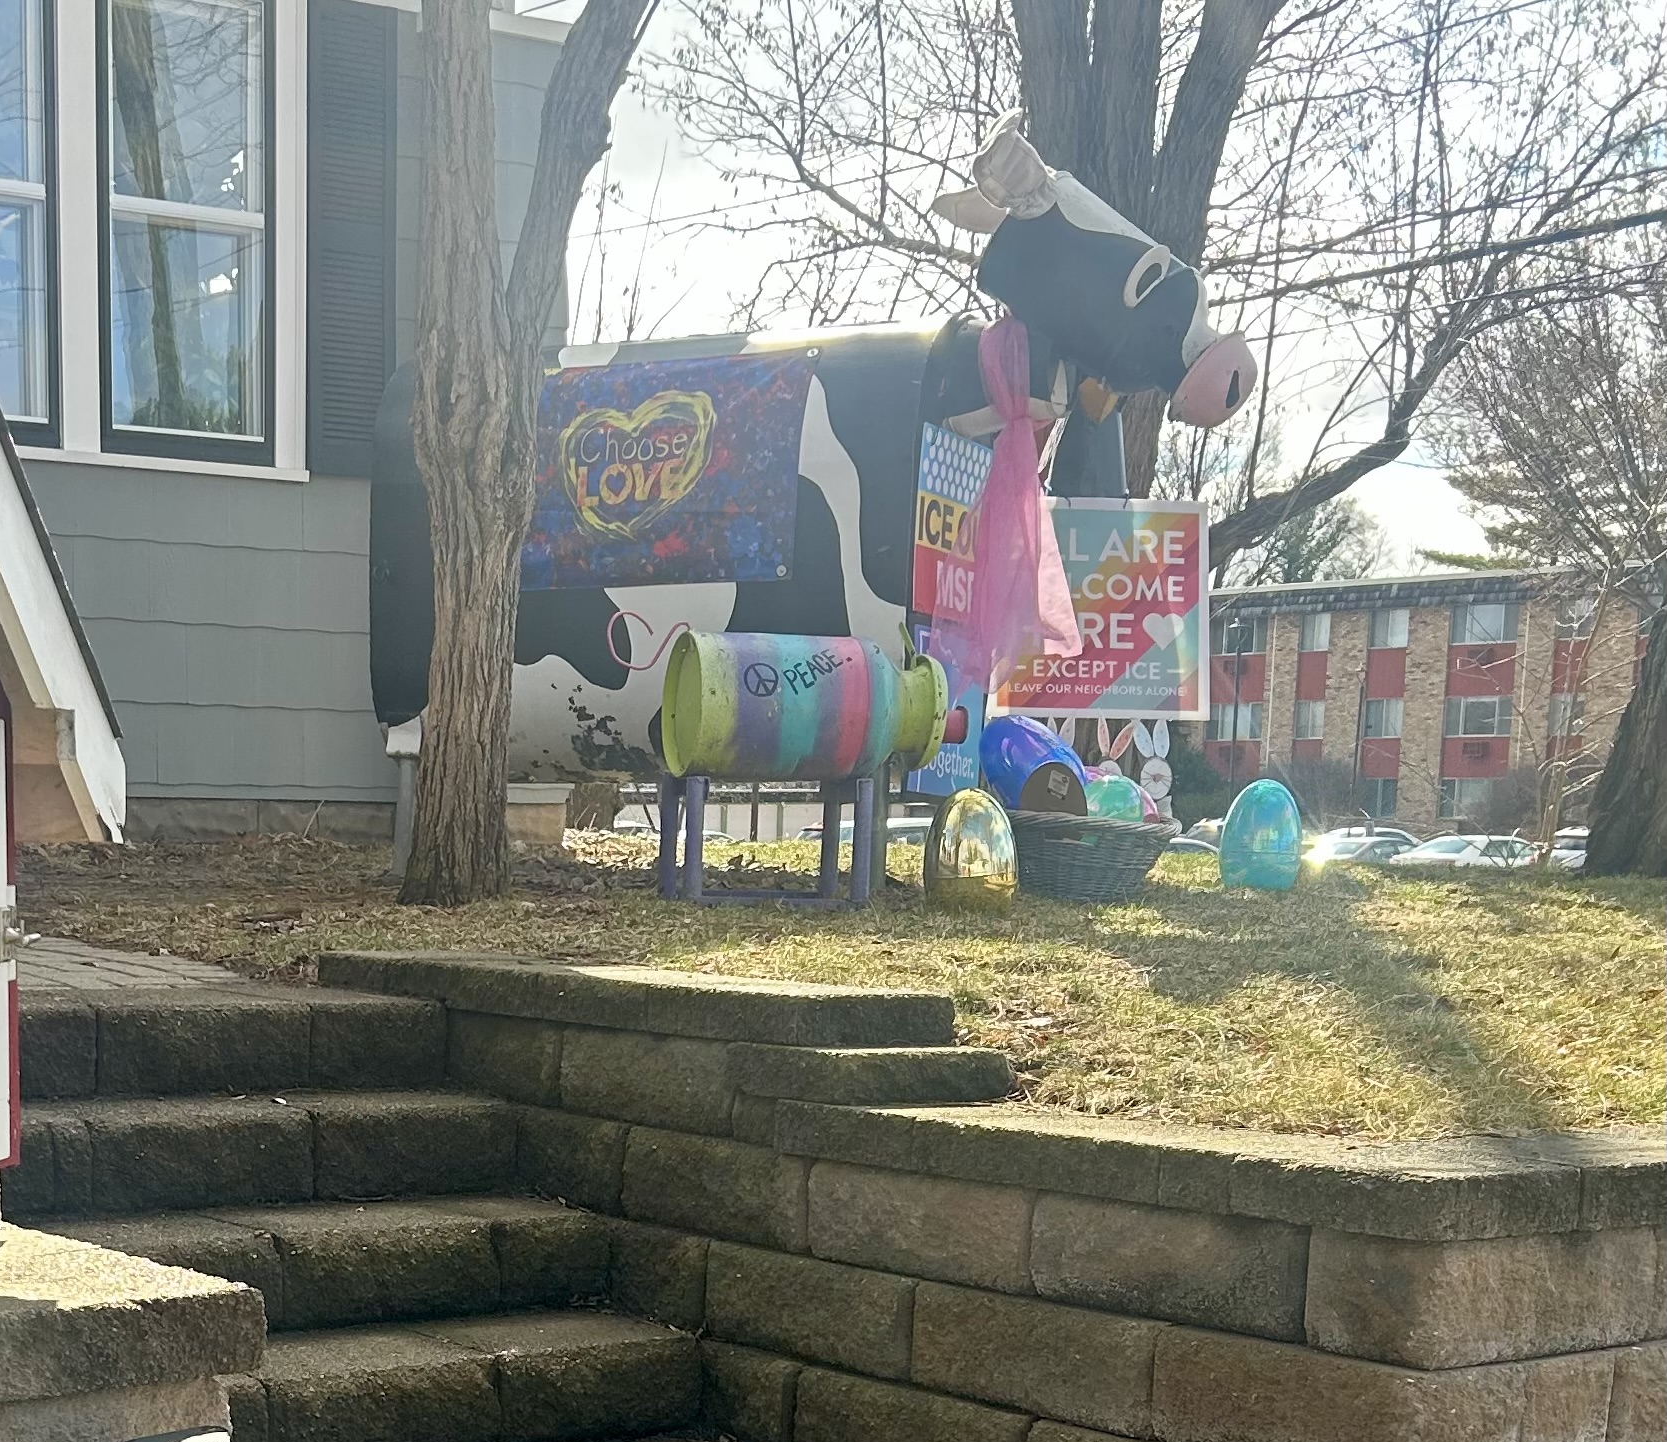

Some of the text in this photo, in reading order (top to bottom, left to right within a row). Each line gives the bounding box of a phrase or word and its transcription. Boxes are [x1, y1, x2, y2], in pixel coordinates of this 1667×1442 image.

[580, 426, 688, 463] Choose
[576, 457, 685, 507] LOVE
[918, 495, 954, 550] ICE
[1098, 528, 1185, 564] ARE
[1032, 658, 1162, 681] EXCEPT ICE
[1045, 683, 1072, 694] OUR
[1074, 684, 1143, 697] NEIGHBORS
